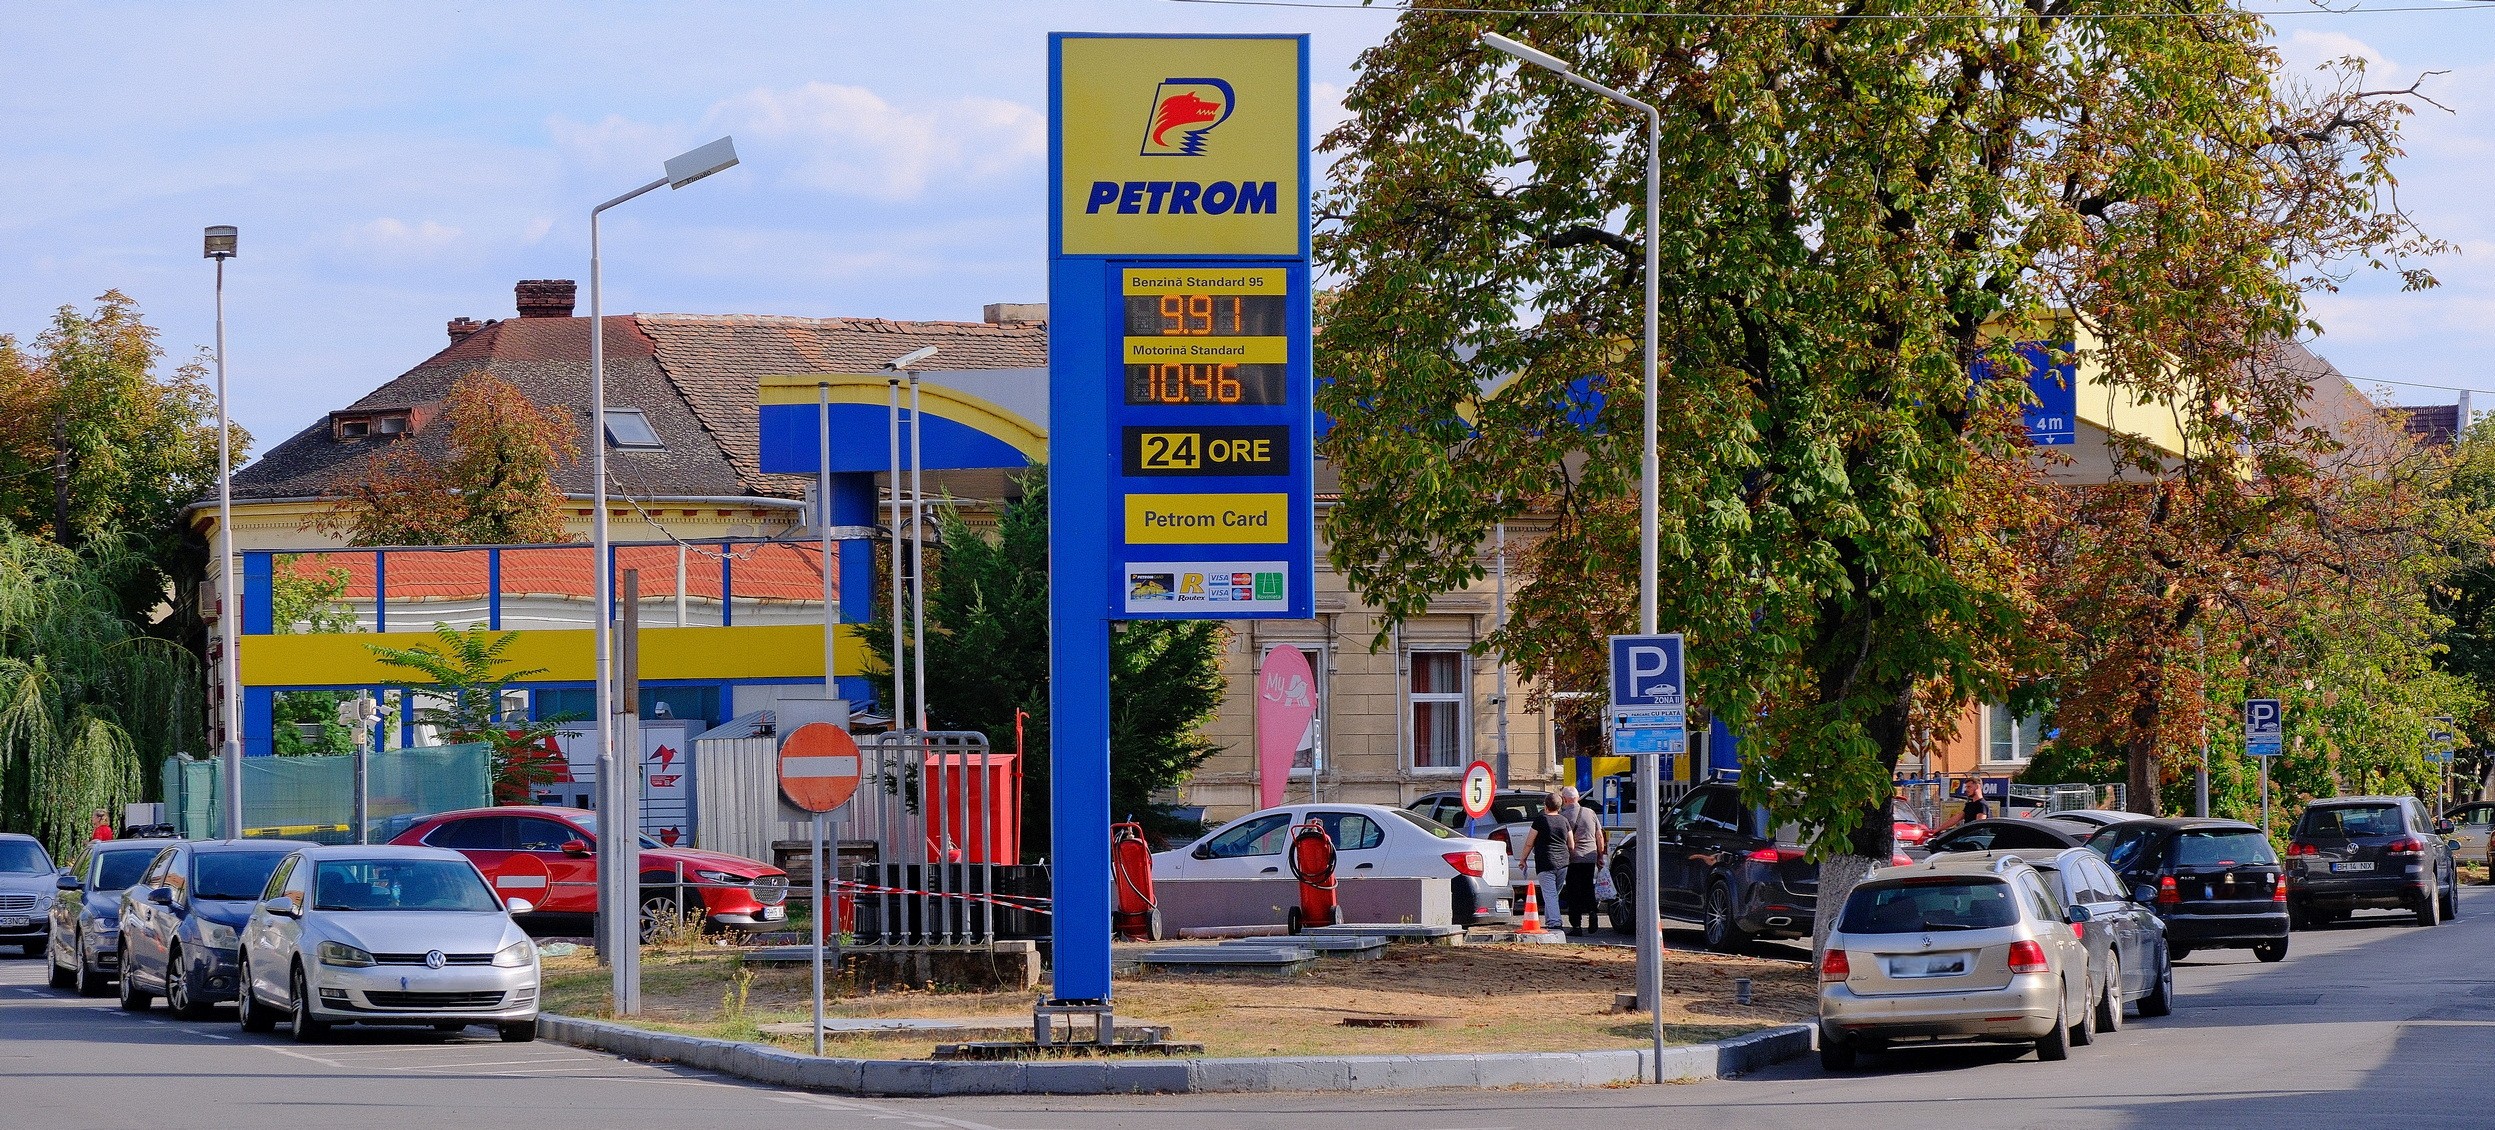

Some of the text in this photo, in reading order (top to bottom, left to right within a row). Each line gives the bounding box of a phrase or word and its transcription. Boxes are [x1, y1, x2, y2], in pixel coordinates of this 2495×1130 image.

[1085, 180, 1278, 215] PETROM
[1132, 276, 1264, 287] Benzină Standard 95
[1160, 294, 1242, 335] 9.91
[1133, 344, 1245, 355] Motorină Standard
[1149, 362, 1241, 403] 10.46
[2036, 416, 2063, 430] 4 m
[1147, 436, 1271, 466] 24 ORE
[1144, 511, 1268, 527] Petrom Card
[1178, 594, 1205, 602] Routex
[1628, 646, 1668, 698] P
[1263, 672, 1285, 702] My
[1654, 696, 1674, 704] ZONA
[2254, 704, 2274, 729] P
[1473, 778, 1483, 804] 5
